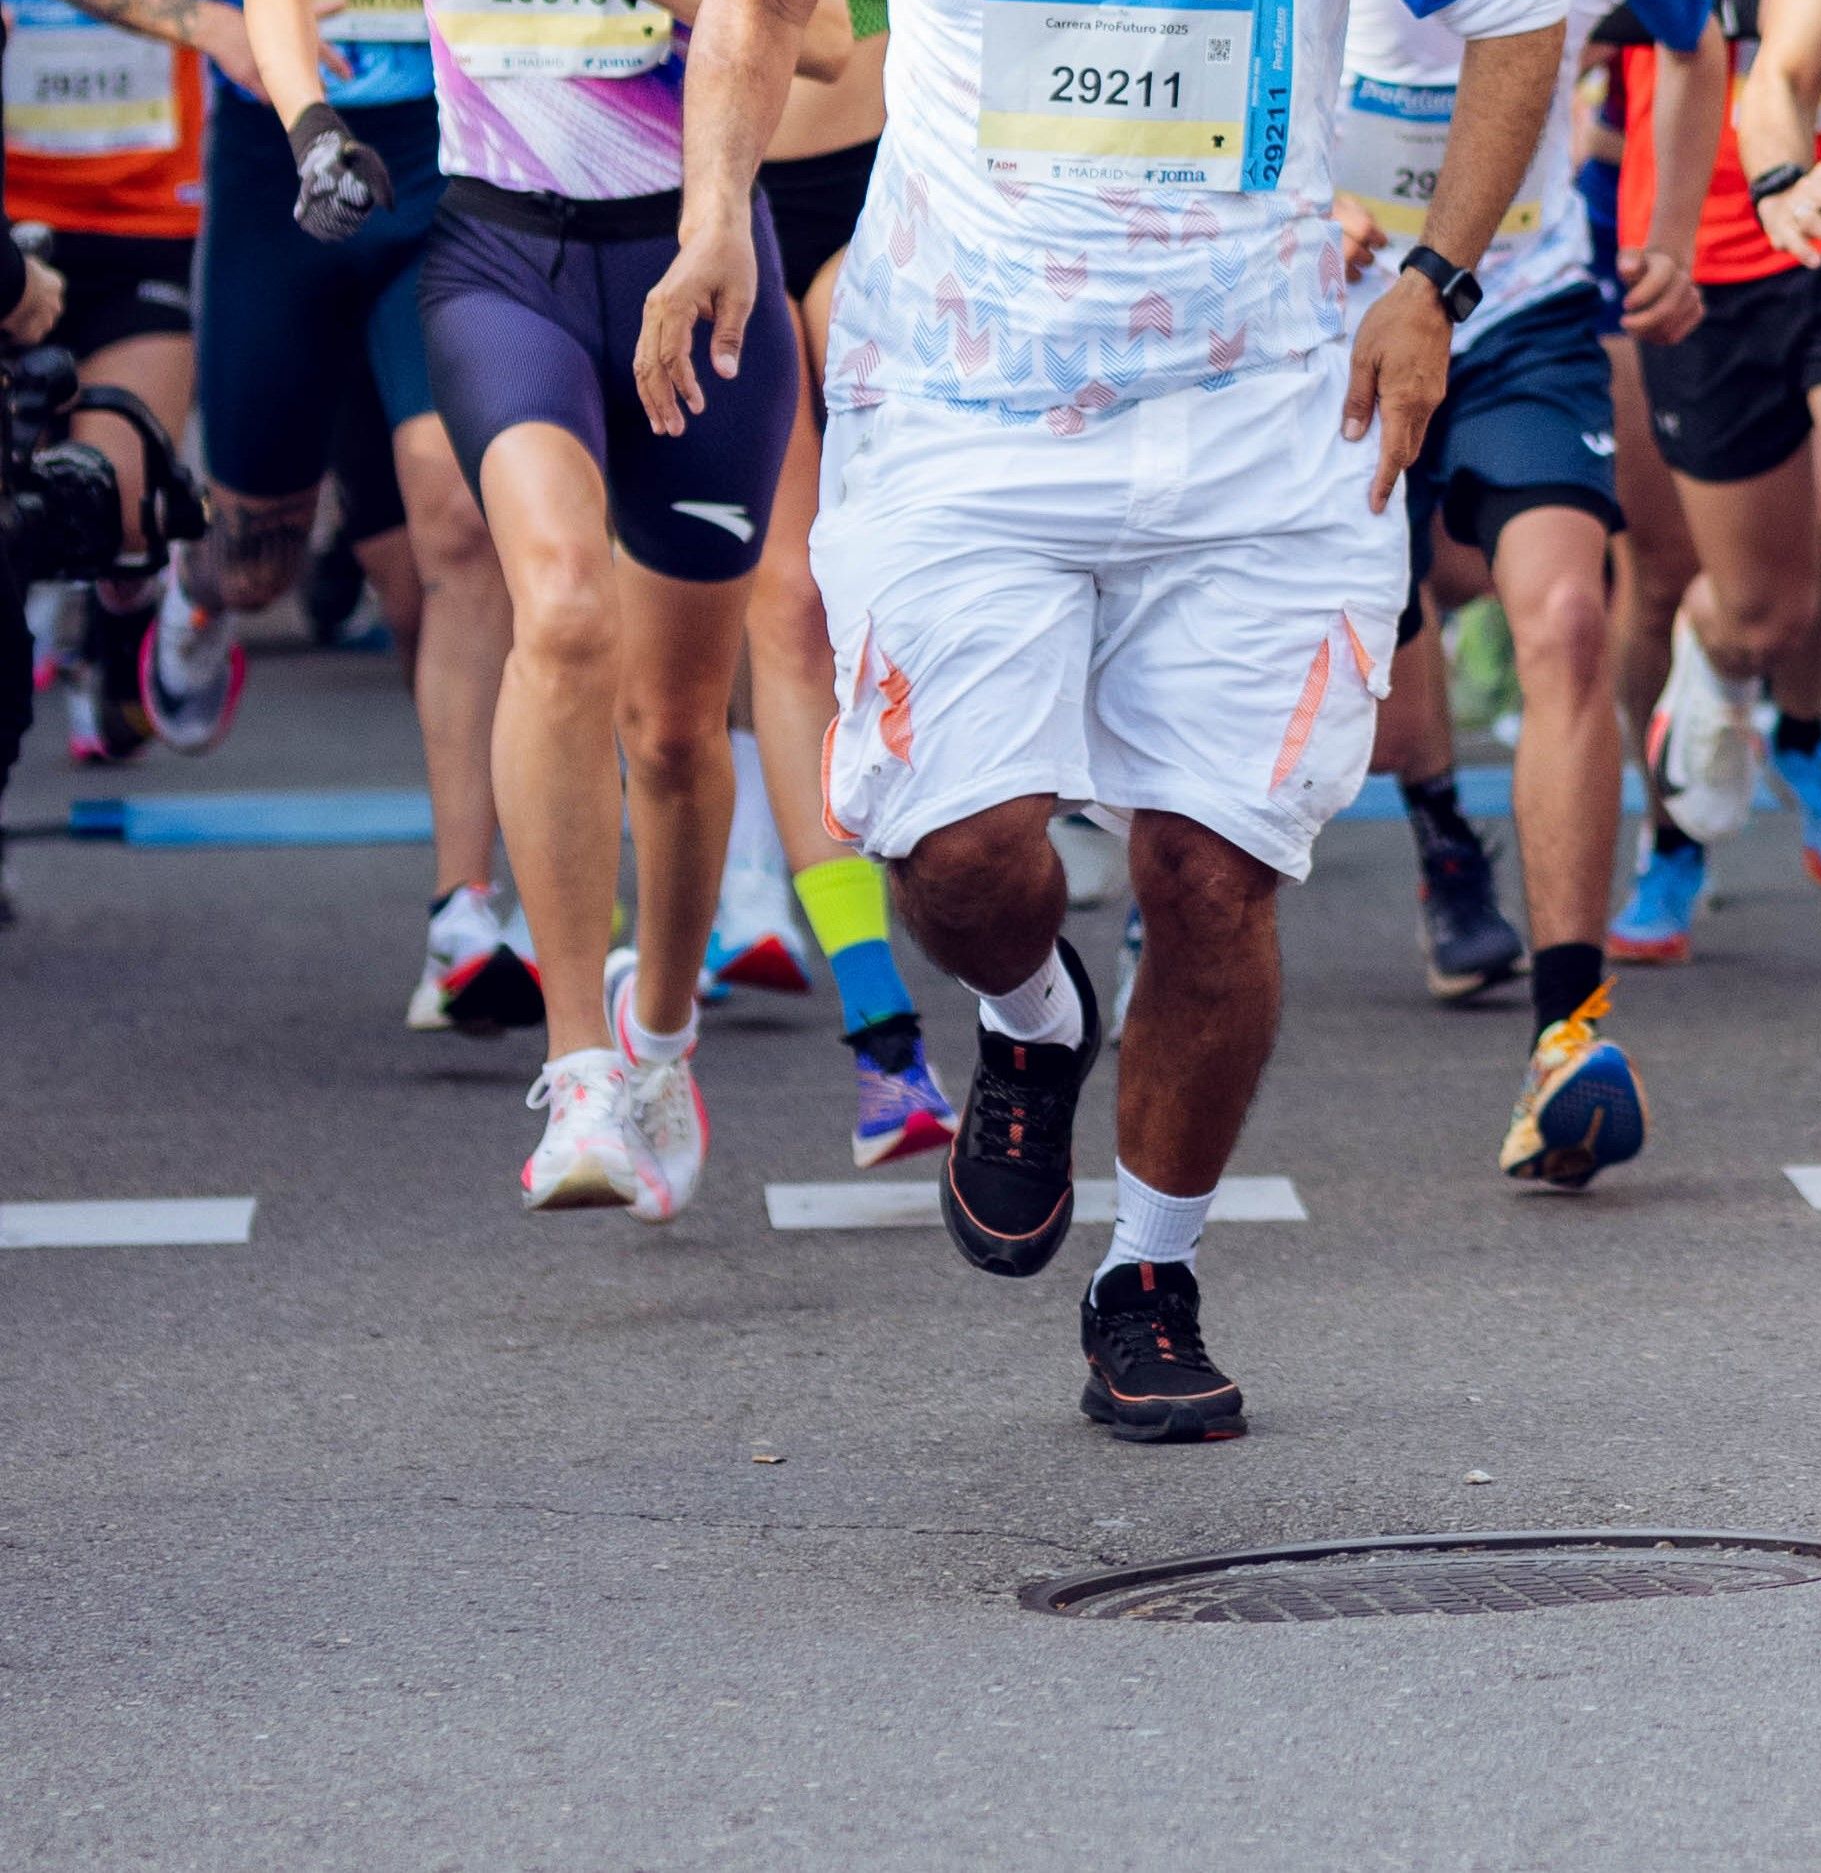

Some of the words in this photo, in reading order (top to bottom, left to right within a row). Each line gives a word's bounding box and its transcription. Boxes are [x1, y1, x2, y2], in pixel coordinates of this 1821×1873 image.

[1045, 17, 1091, 31] Carrera
[1095, 20, 1156, 34] ProFuturo
[1159, 23, 1189, 35] 2025
[1049, 66, 1180, 109] 29211
[1262, 86, 1288, 183] 29211
[1068, 166, 1124, 179] MADRID
